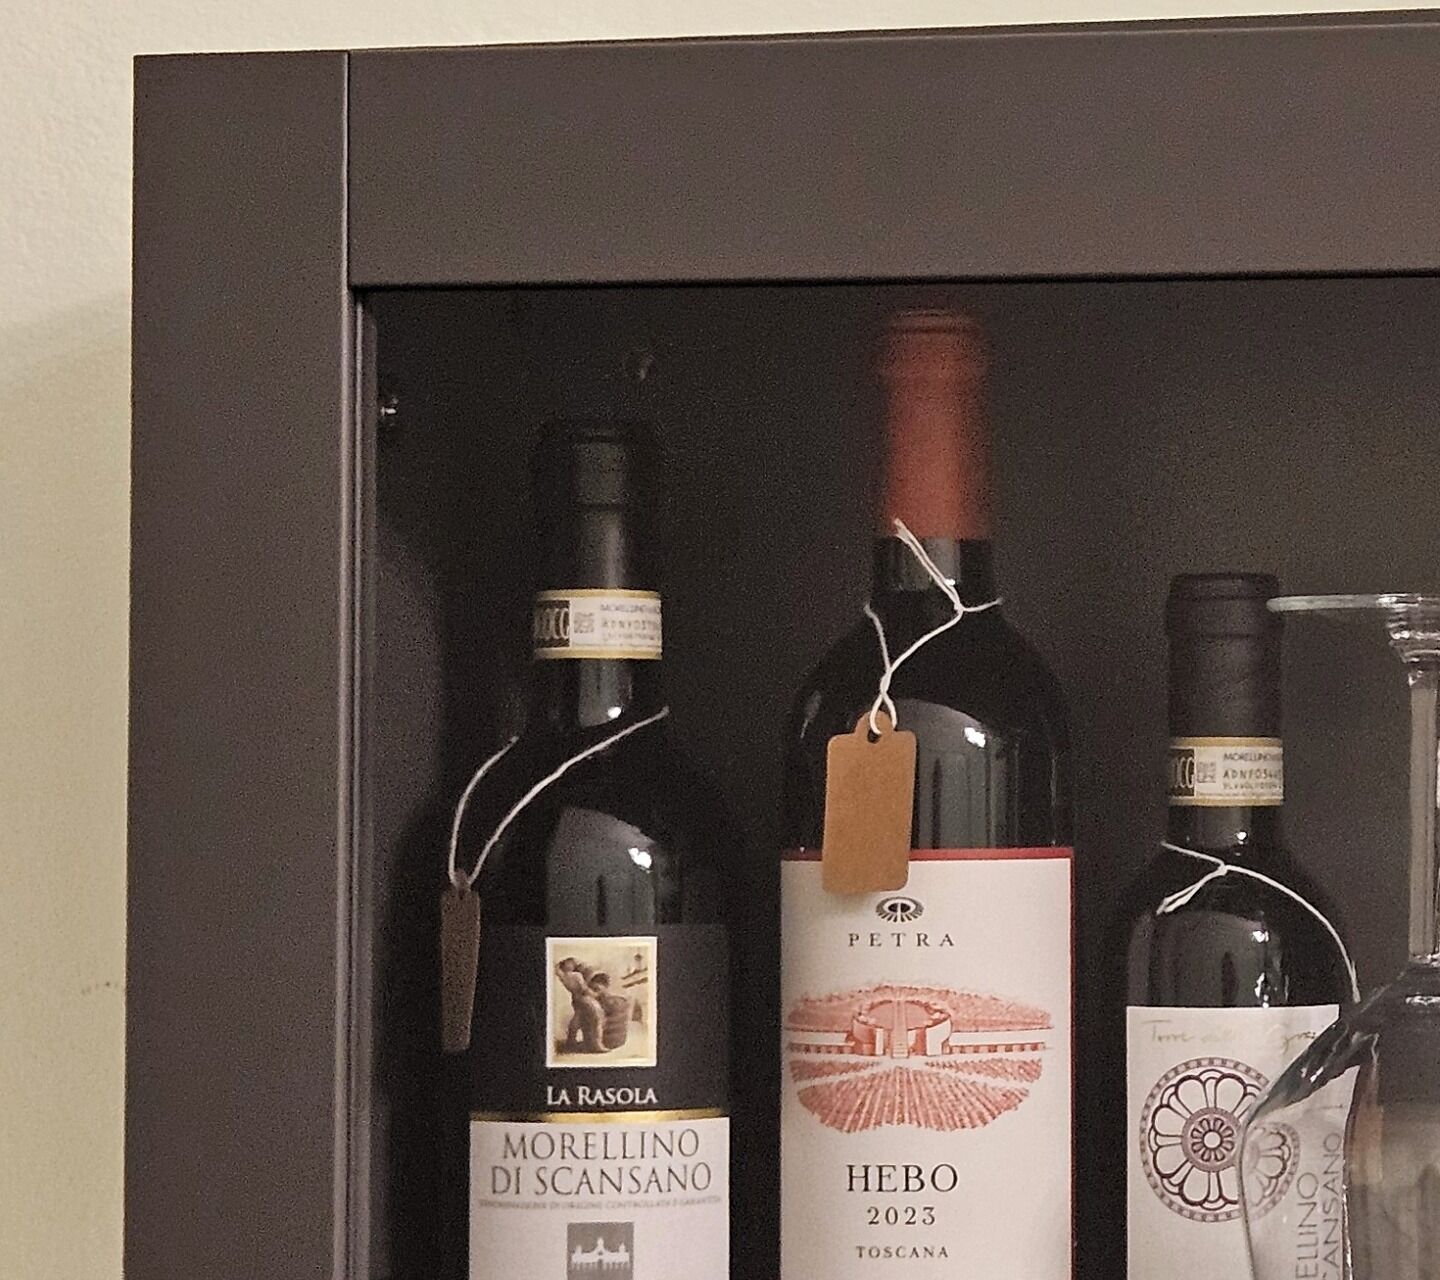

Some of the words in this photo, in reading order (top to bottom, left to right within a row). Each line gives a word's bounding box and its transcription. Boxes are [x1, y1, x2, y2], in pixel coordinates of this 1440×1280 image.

[848, 932, 955, 948] PETRA
[502, 1128, 700, 1160] MORELLINO
[491, 1165, 521, 1195] DI
[534, 1161, 712, 1195] SCANSANO
[846, 1163, 959, 1193] HEBO
[867, 1206, 936, 1226] 2023
[856, 1245, 950, 1259] TOSCANA
